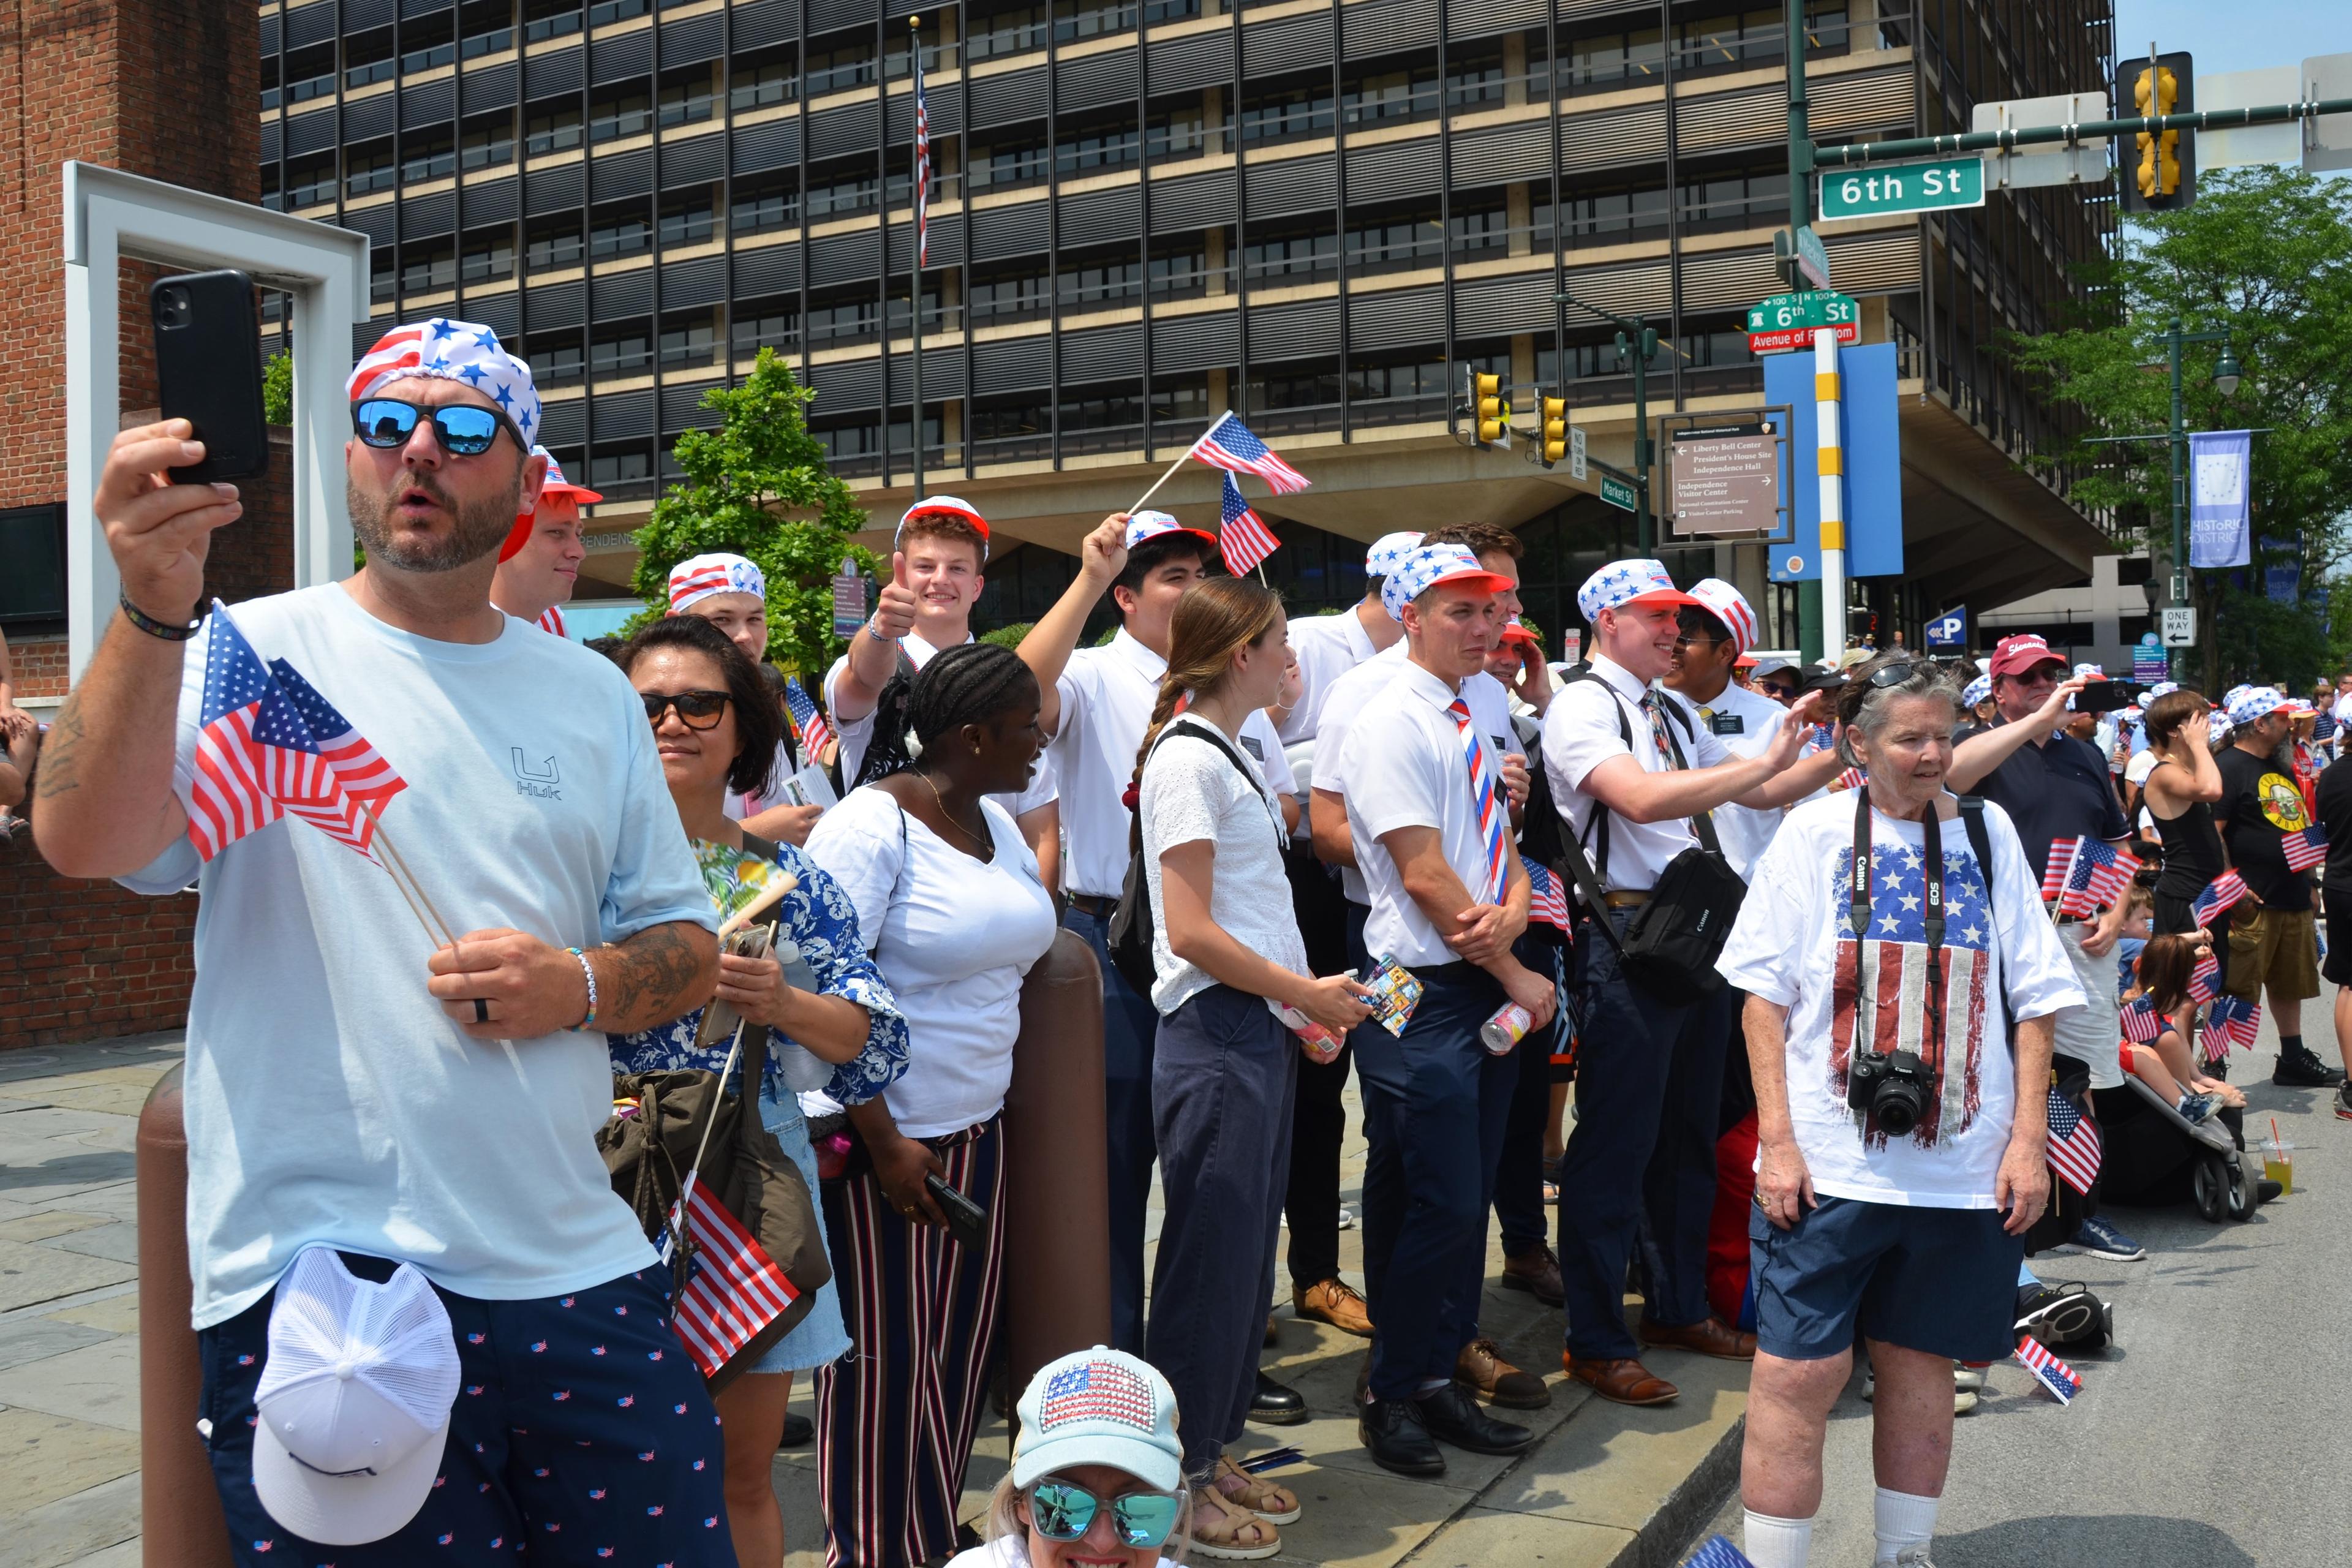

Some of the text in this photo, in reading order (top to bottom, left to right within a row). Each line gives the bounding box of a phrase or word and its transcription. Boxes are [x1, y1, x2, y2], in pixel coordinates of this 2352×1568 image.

[1841, 168, 1961, 204] 6th St
[1777, 303, 1849, 326] 6th St
[1754, 334, 1790, 348] Avenue
[1794, 331, 1804, 343] of
[1574, 432, 1582, 445] NO
[1694, 454, 1732, 463] President's
[1694, 466, 1743, 475] Independence
[1604, 481, 1632, 504] Market St
[1678, 481, 1728, 491] Independence
[2168, 611, 2188, 620] ONE
[1943, 618, 1962, 639] P
[2166, 622, 2189, 630] WAY
[1856, 856, 1867, 891] Canon
[1930, 882, 1940, 906] EOS
[1697, 909, 1709, 932] Canon
